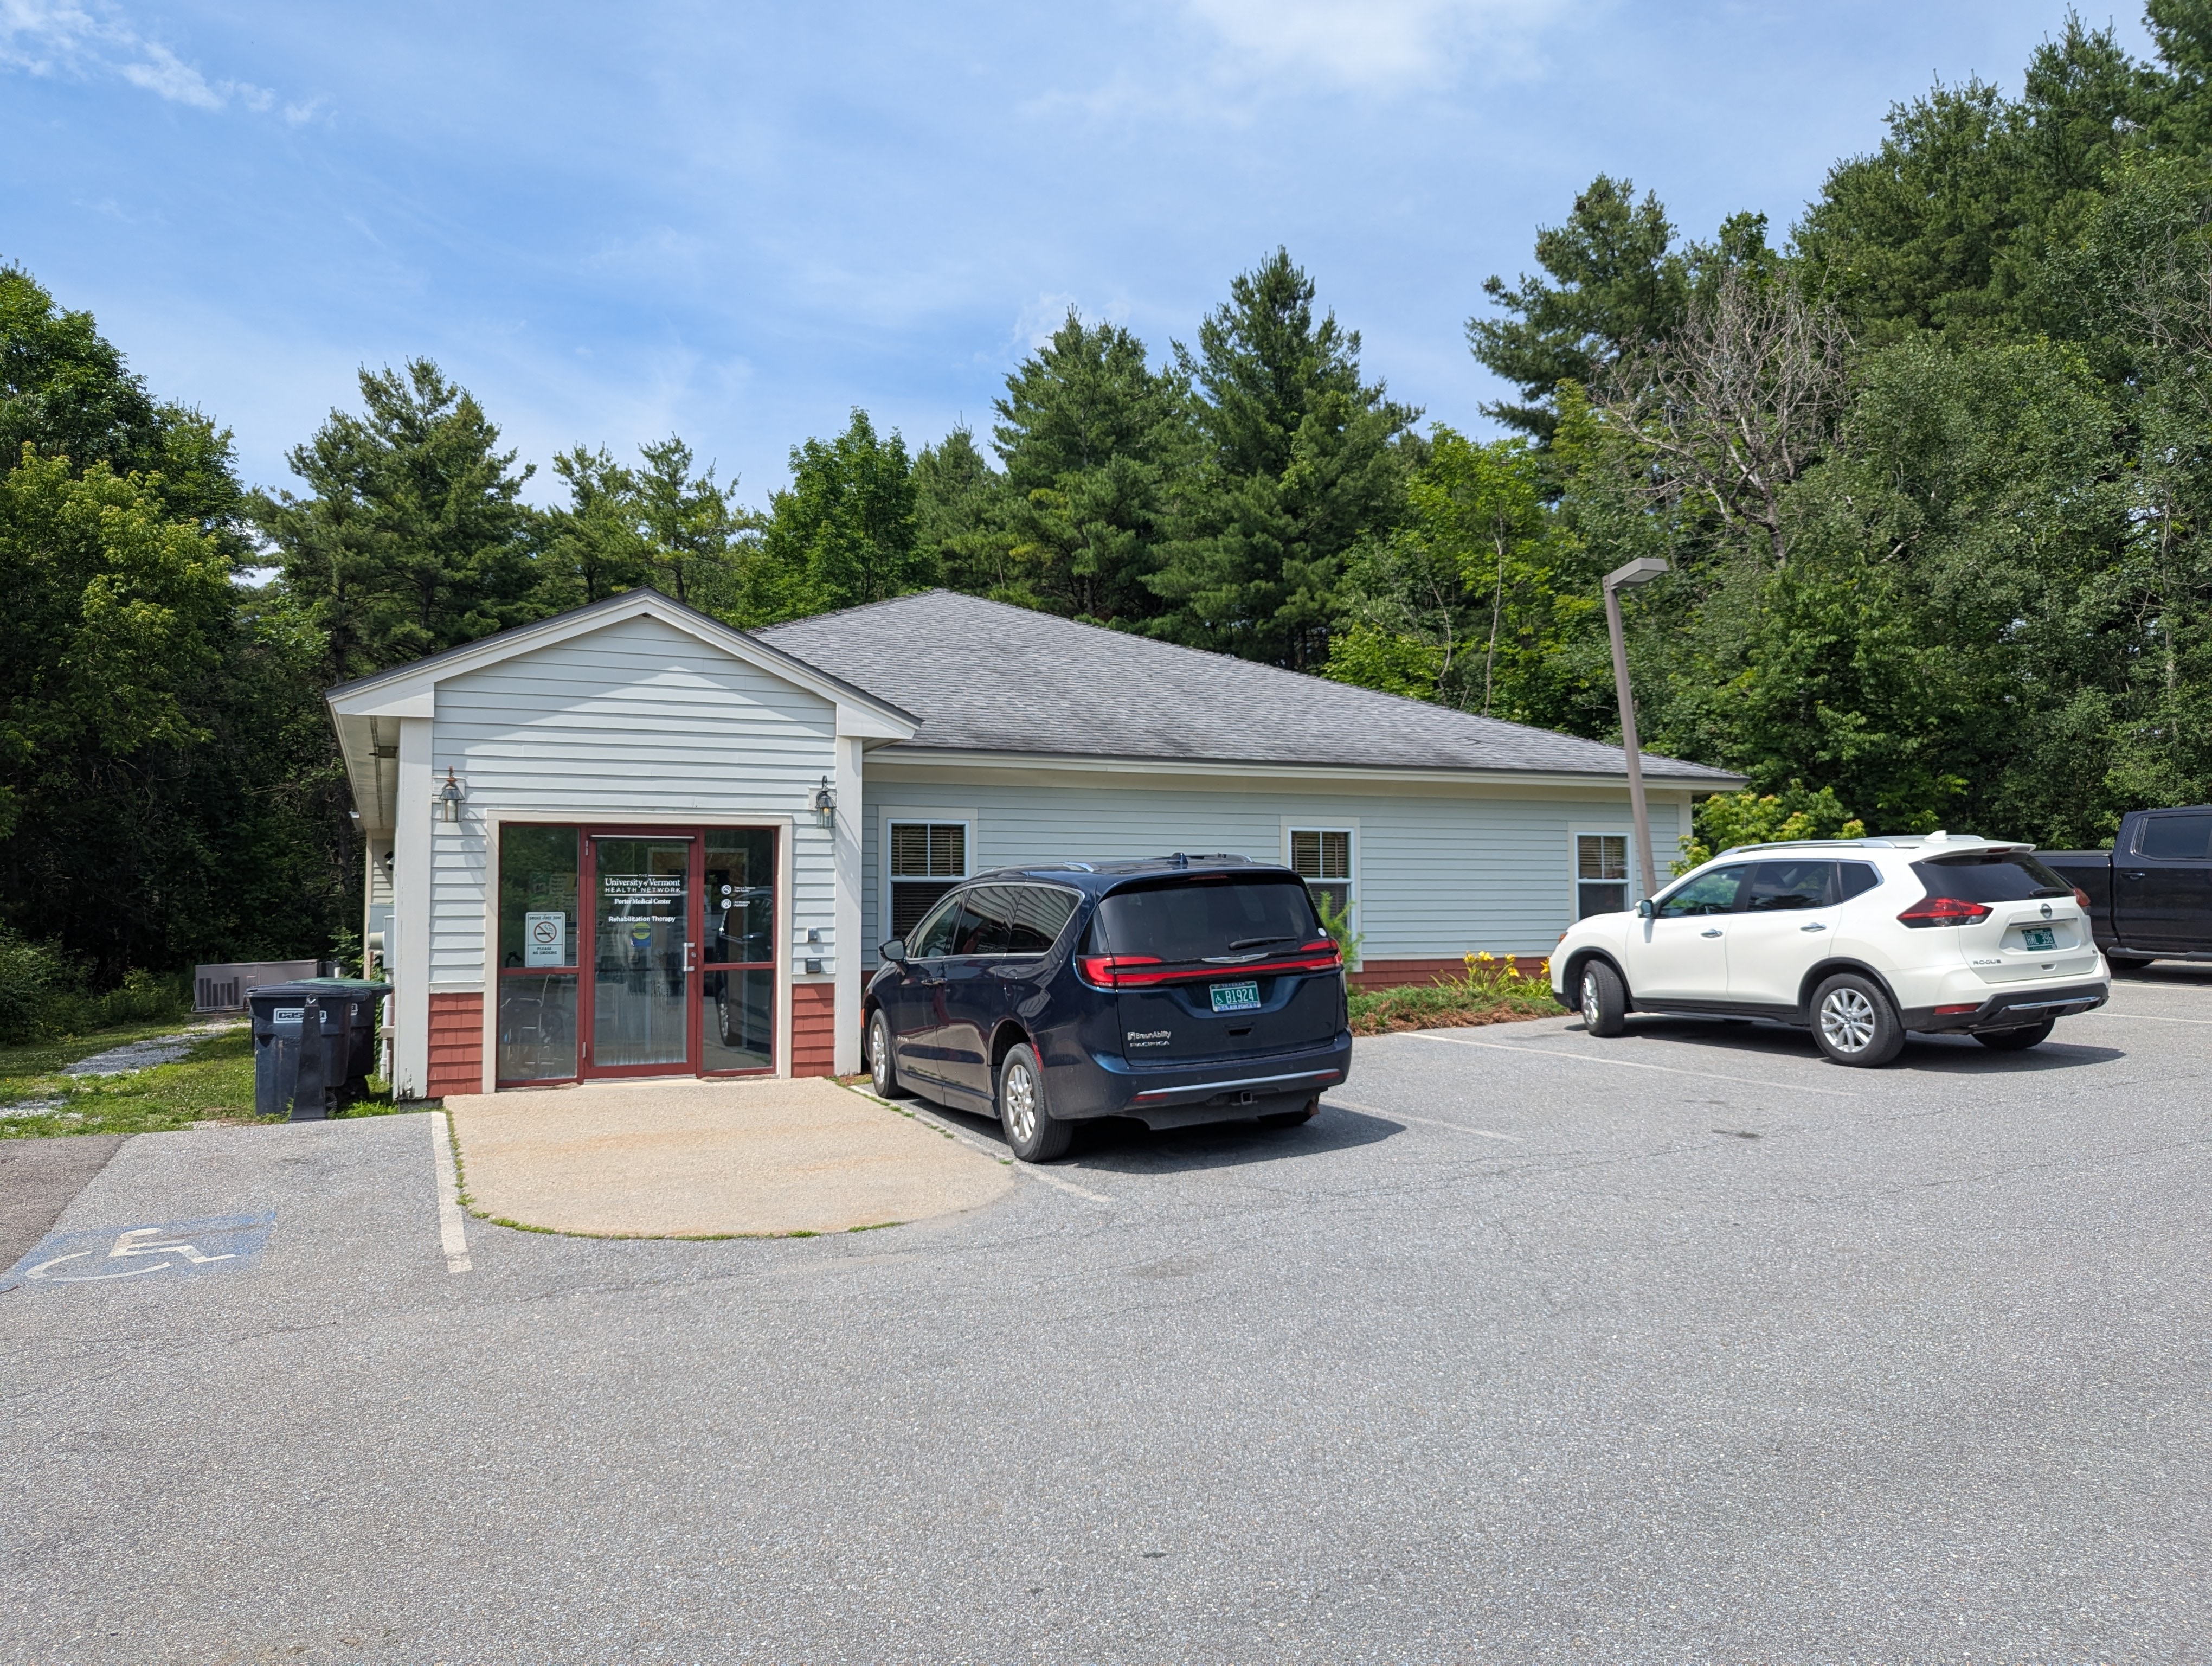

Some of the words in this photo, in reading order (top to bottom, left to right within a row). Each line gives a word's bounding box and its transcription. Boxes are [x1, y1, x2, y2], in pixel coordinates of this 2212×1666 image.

[605, 878, 643, 888] University
[648, 878, 681, 886] Vermont
[2026, 934, 2039, 945] HML
[2040, 933, 2053, 944] 396
[1225, 988, 1254, 1003] B1924
[1135, 1030, 1171, 1039] BraunAbility
